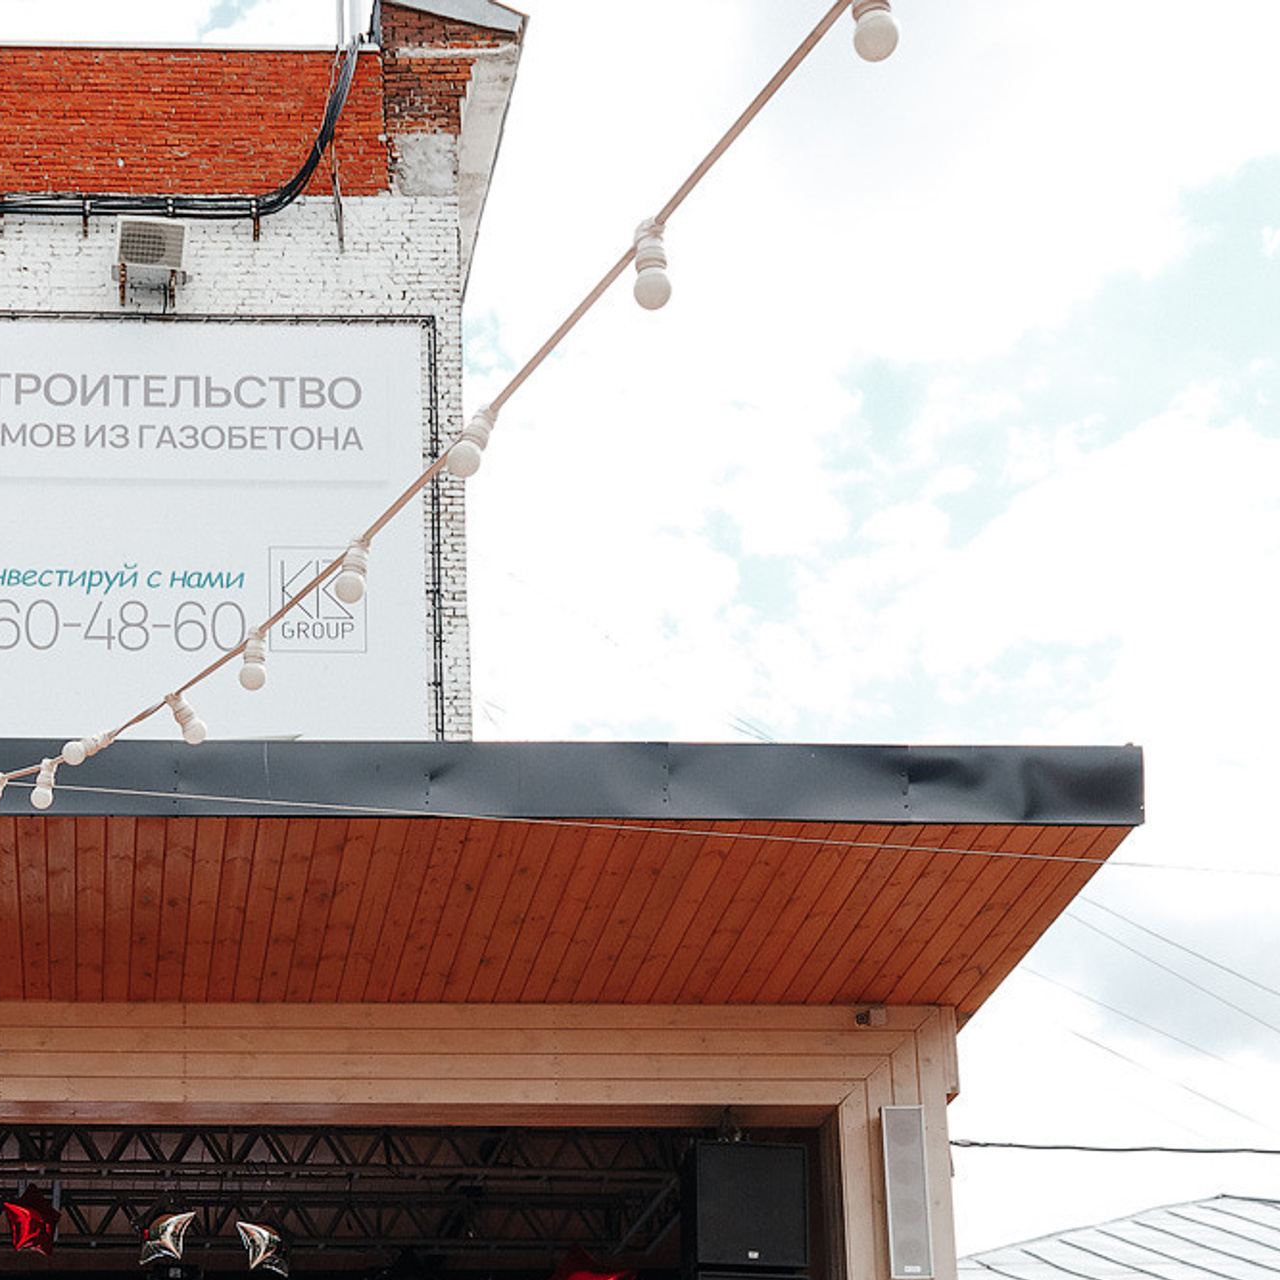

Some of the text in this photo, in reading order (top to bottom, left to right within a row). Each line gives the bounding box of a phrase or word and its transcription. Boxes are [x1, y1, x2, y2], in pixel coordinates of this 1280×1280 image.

[84, 423, 130, 449] ИЗ
[138, 424, 364, 451] ГАЗОБЕТОНА
[146, 573, 163, 588] с
[169, 571, 245, 588] нами
[281, 621, 355, 640] GROUP
